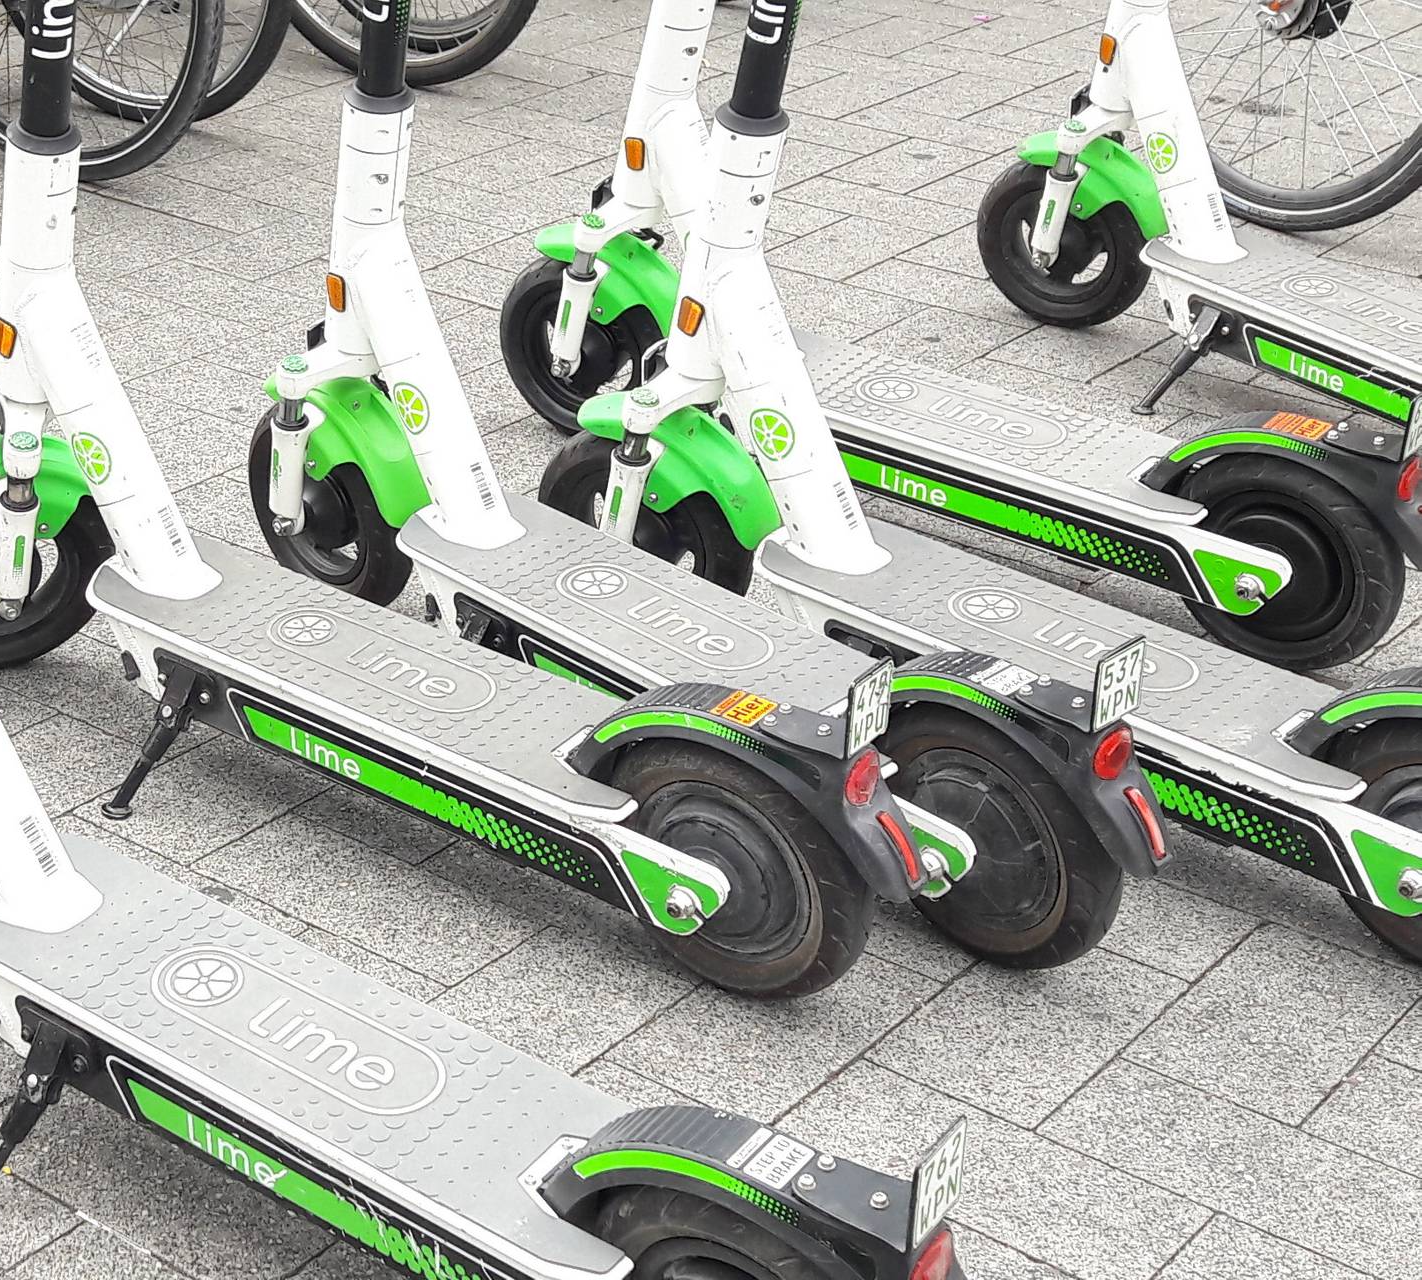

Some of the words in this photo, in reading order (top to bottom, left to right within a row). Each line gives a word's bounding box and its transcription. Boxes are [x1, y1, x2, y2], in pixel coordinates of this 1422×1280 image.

[1289, 351, 1344, 393] Lime
[926, 395, 1033, 440] Lime
[879, 465, 948, 508] Lime
[625, 597, 735, 658] Lime
[346, 640, 457, 698] Lime
[1102, 650, 1140, 691] 537
[727, 697, 763, 721] Hier
[853, 702, 886, 749] WPU
[1100, 680, 1137, 725] WPN
[289, 726, 361, 780] Lime
[248, 997, 397, 1091] Lime
[186, 1112, 279, 1188] Lime
[749, 1151, 775, 1175] STEP
[773, 1138, 791, 1152] TO
[765, 1147, 806, 1184] BRAKE
[925, 1131, 961, 1196] 762
[921, 1166, 959, 1235] WPN
